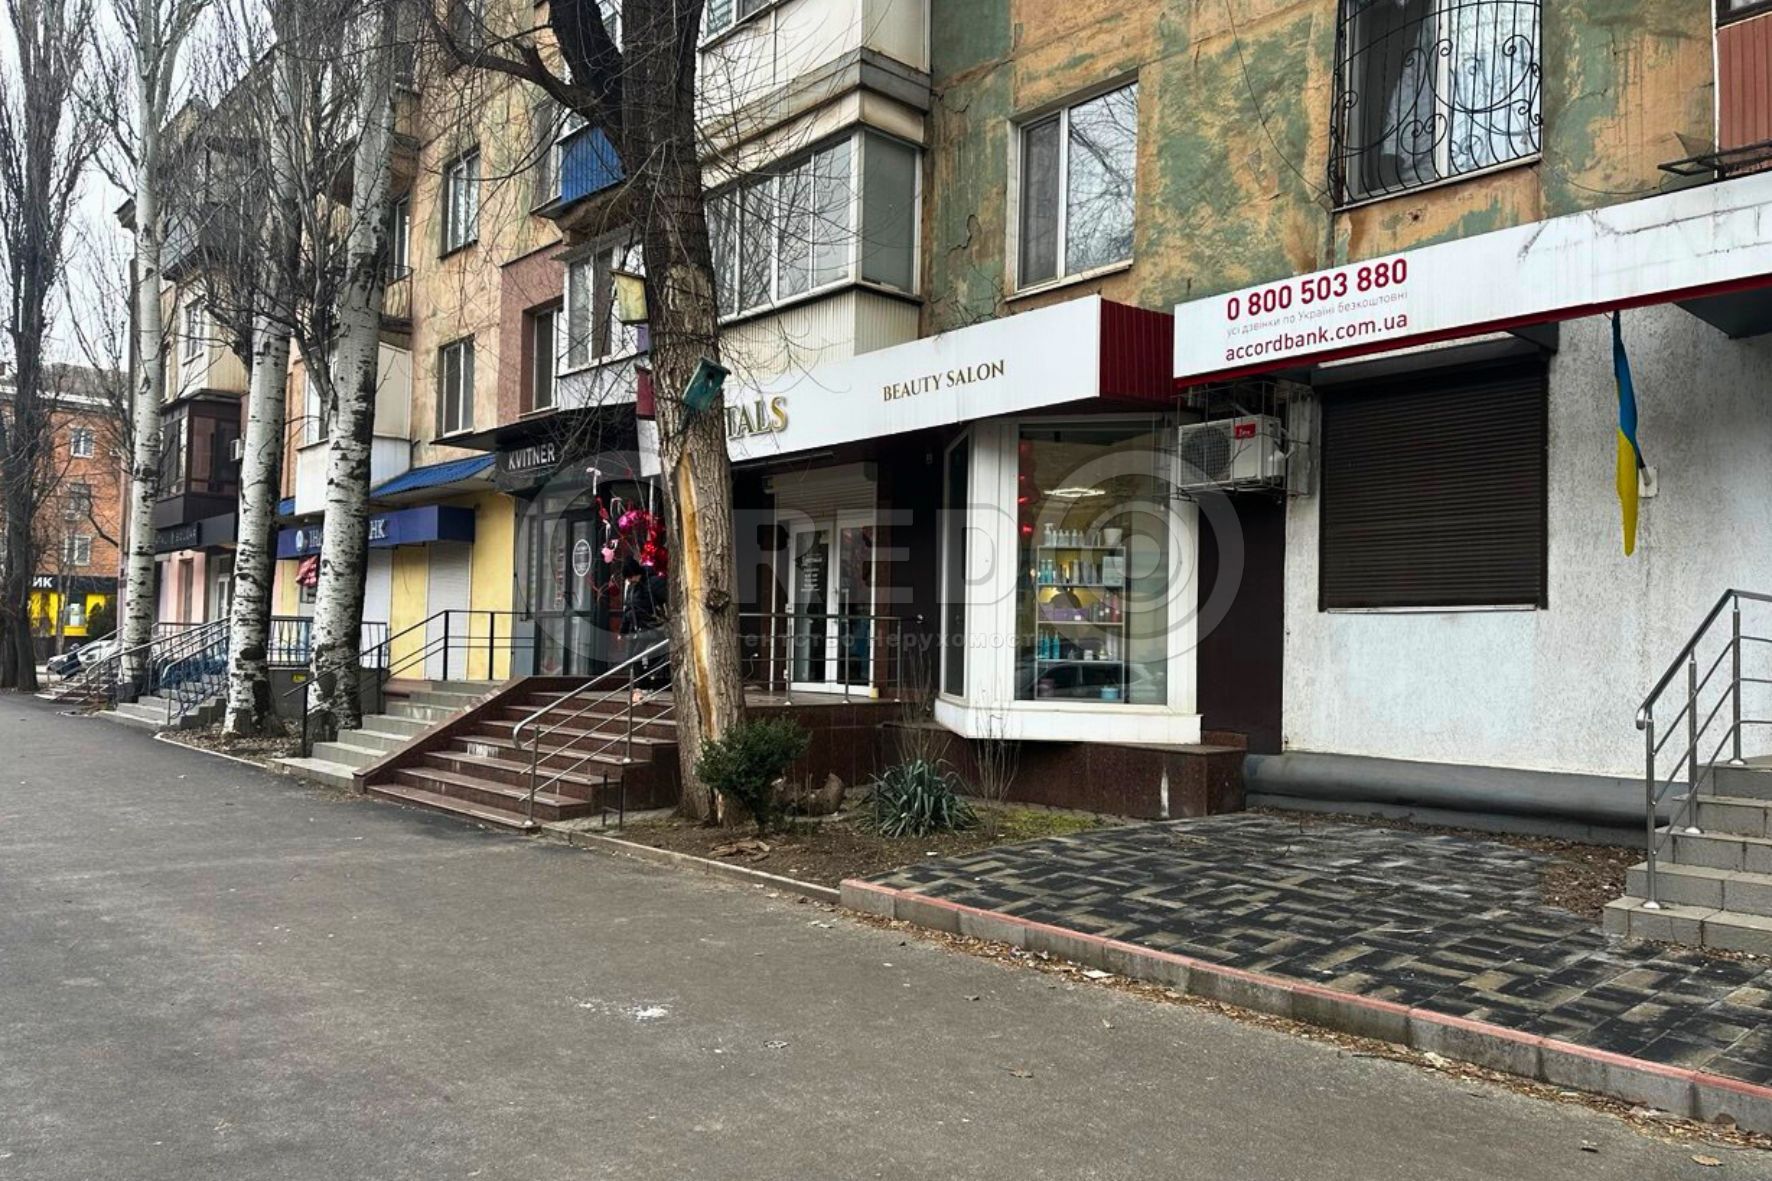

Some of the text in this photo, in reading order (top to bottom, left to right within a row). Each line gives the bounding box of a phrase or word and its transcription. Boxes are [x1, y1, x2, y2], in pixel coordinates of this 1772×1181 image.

[1227, 258, 1407, 321] 0 800 503 880
[1283, 314, 1296, 326] по
[1338, 291, 1408, 314] безкоштовні
[1225, 314, 1408, 361] accordbank.com.ua
[883, 360, 1005, 402] BEAUTY SALON
[724, 396, 789, 440] TALS
[508, 442, 555, 470] KVITNER
[368, 519, 386, 540] НК
[33, 576, 53, 588] ИК
